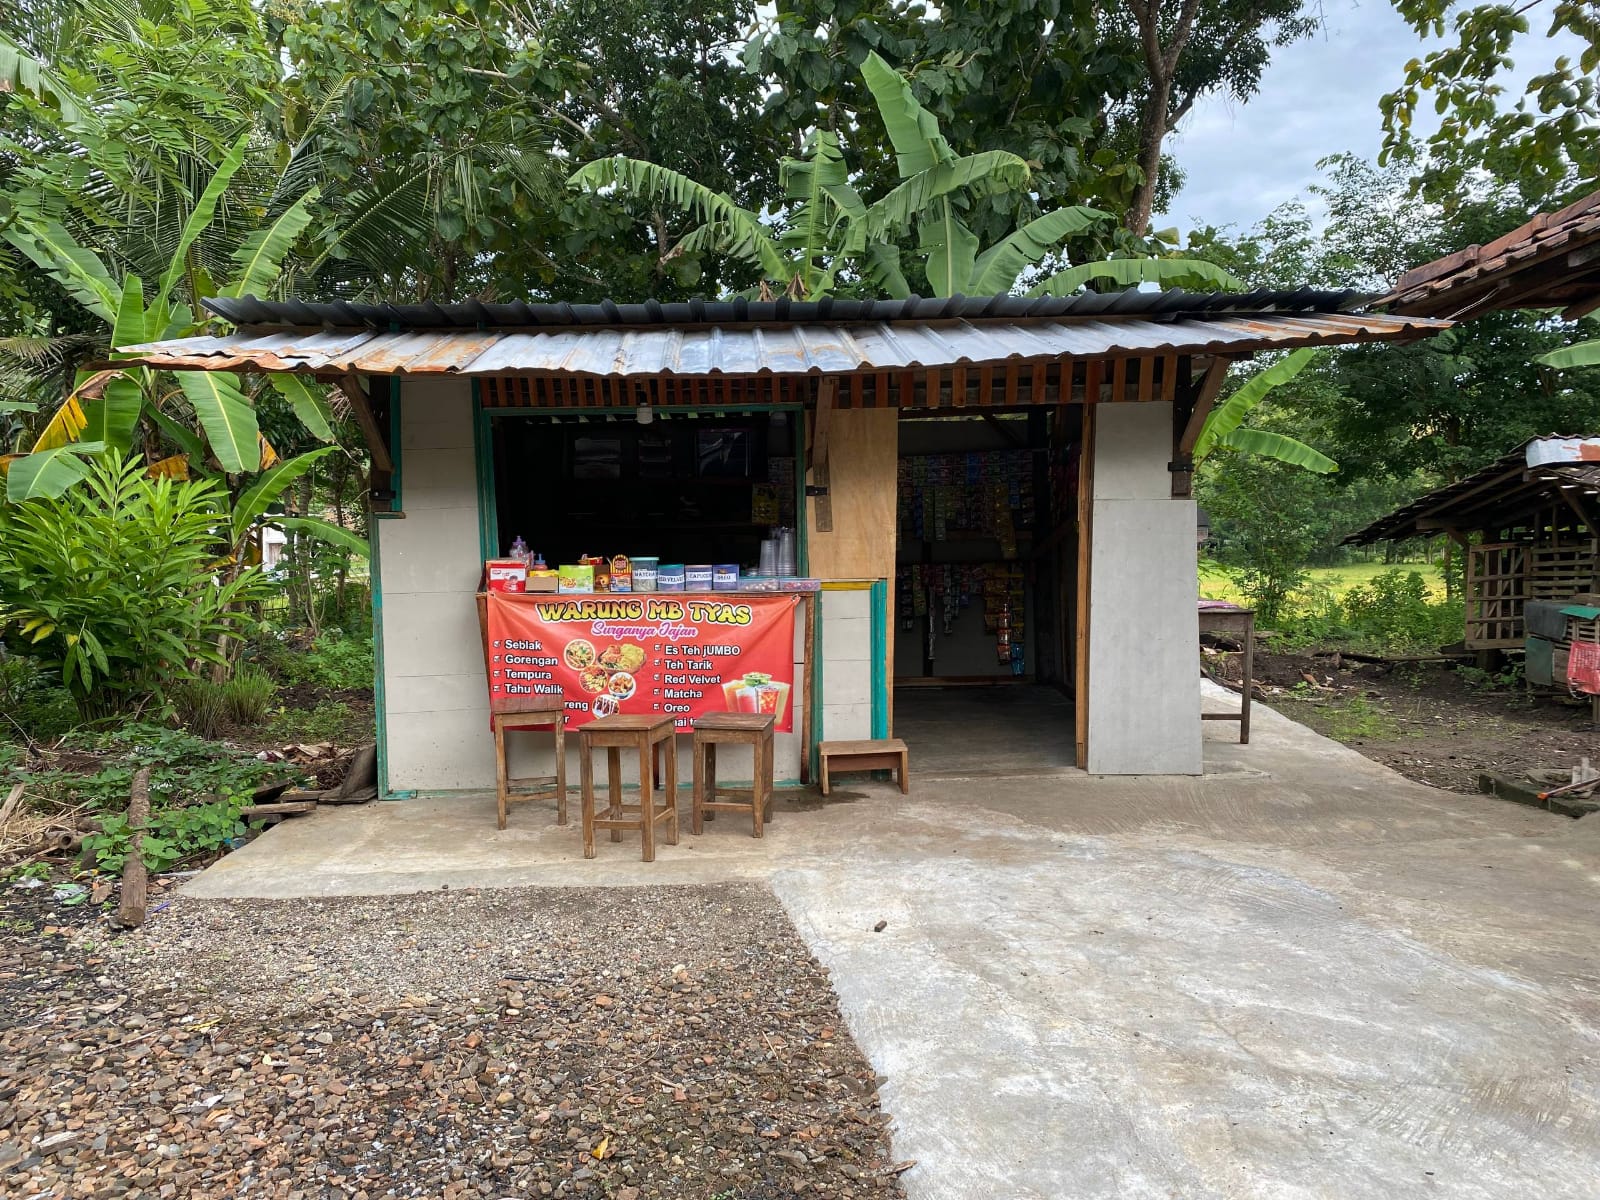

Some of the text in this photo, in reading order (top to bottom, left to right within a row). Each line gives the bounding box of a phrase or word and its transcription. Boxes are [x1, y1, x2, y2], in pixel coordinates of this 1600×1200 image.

[537, 600, 751, 625] WARUNG MB TYAS
[592, 621, 697, 639] Surganya Jajan
[505, 640, 542, 650] Seblak
[665, 646, 678, 655] Es
[682, 646, 700, 655] Teh
[505, 655, 558, 667] Gorengan
[665, 660, 713, 670] Teh Tarik
[505, 669, 552, 681] Tempura
[664, 675, 720, 684] Red Velvet
[504, 684, 563, 695] Tahu Walik
[664, 689, 703, 698] Matcha
[564, 701, 589, 712] reng
[664, 704, 690, 712] Oreo
